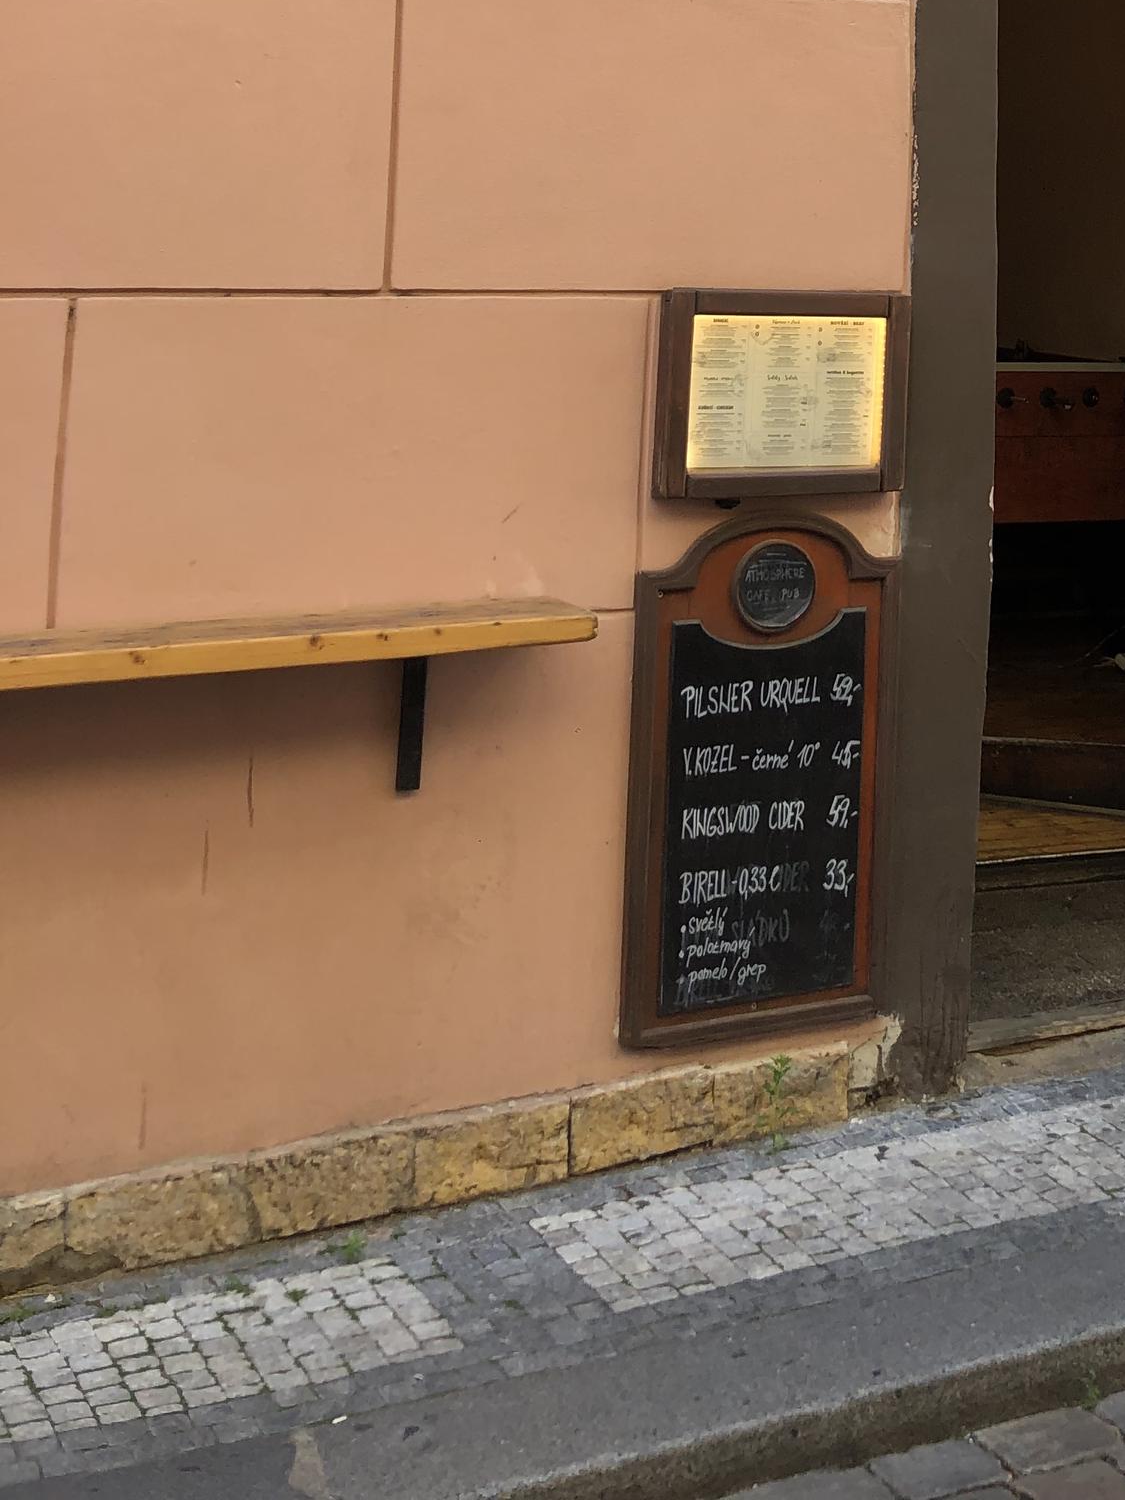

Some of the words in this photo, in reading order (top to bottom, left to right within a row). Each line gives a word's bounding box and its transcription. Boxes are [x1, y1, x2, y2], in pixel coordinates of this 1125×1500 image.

[681, 680, 754, 719] PILSNER
[761, 676, 821, 716] URQUELL
[681, 803, 760, 839] KINGSWOOD
[768, 800, 805, 831] CIDER
